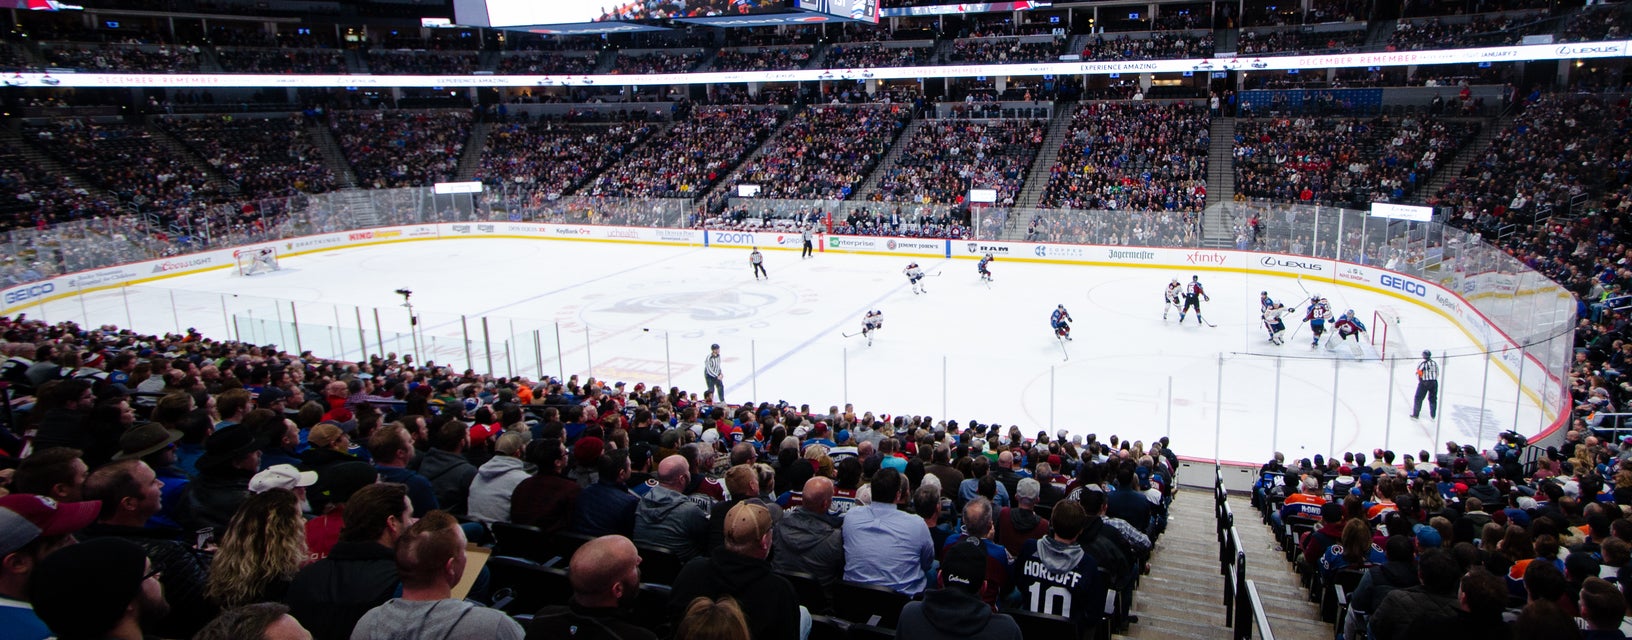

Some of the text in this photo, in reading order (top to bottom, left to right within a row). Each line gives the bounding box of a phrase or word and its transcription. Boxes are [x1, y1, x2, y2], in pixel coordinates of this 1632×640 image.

[1572, 45, 1619, 54] LEXUS
[1299, 56, 1353, 66] DECEMBER
[1360, 54, 1418, 64] REMEMBER
[1080, 62, 1158, 72] EXPERIENCE AMAZING
[98, 76, 219, 84] DECEMBER REMEMBER
[715, 232, 754, 244] zoom
[1186, 251, 1227, 264] xfinity
[1278, 259, 1322, 271] LEXUS
[1380, 274, 1427, 297] GEICO
[5, 283, 55, 304] GEICO
[1313, 308, 1323, 319] 83
[1028, 581, 1072, 618] 10
